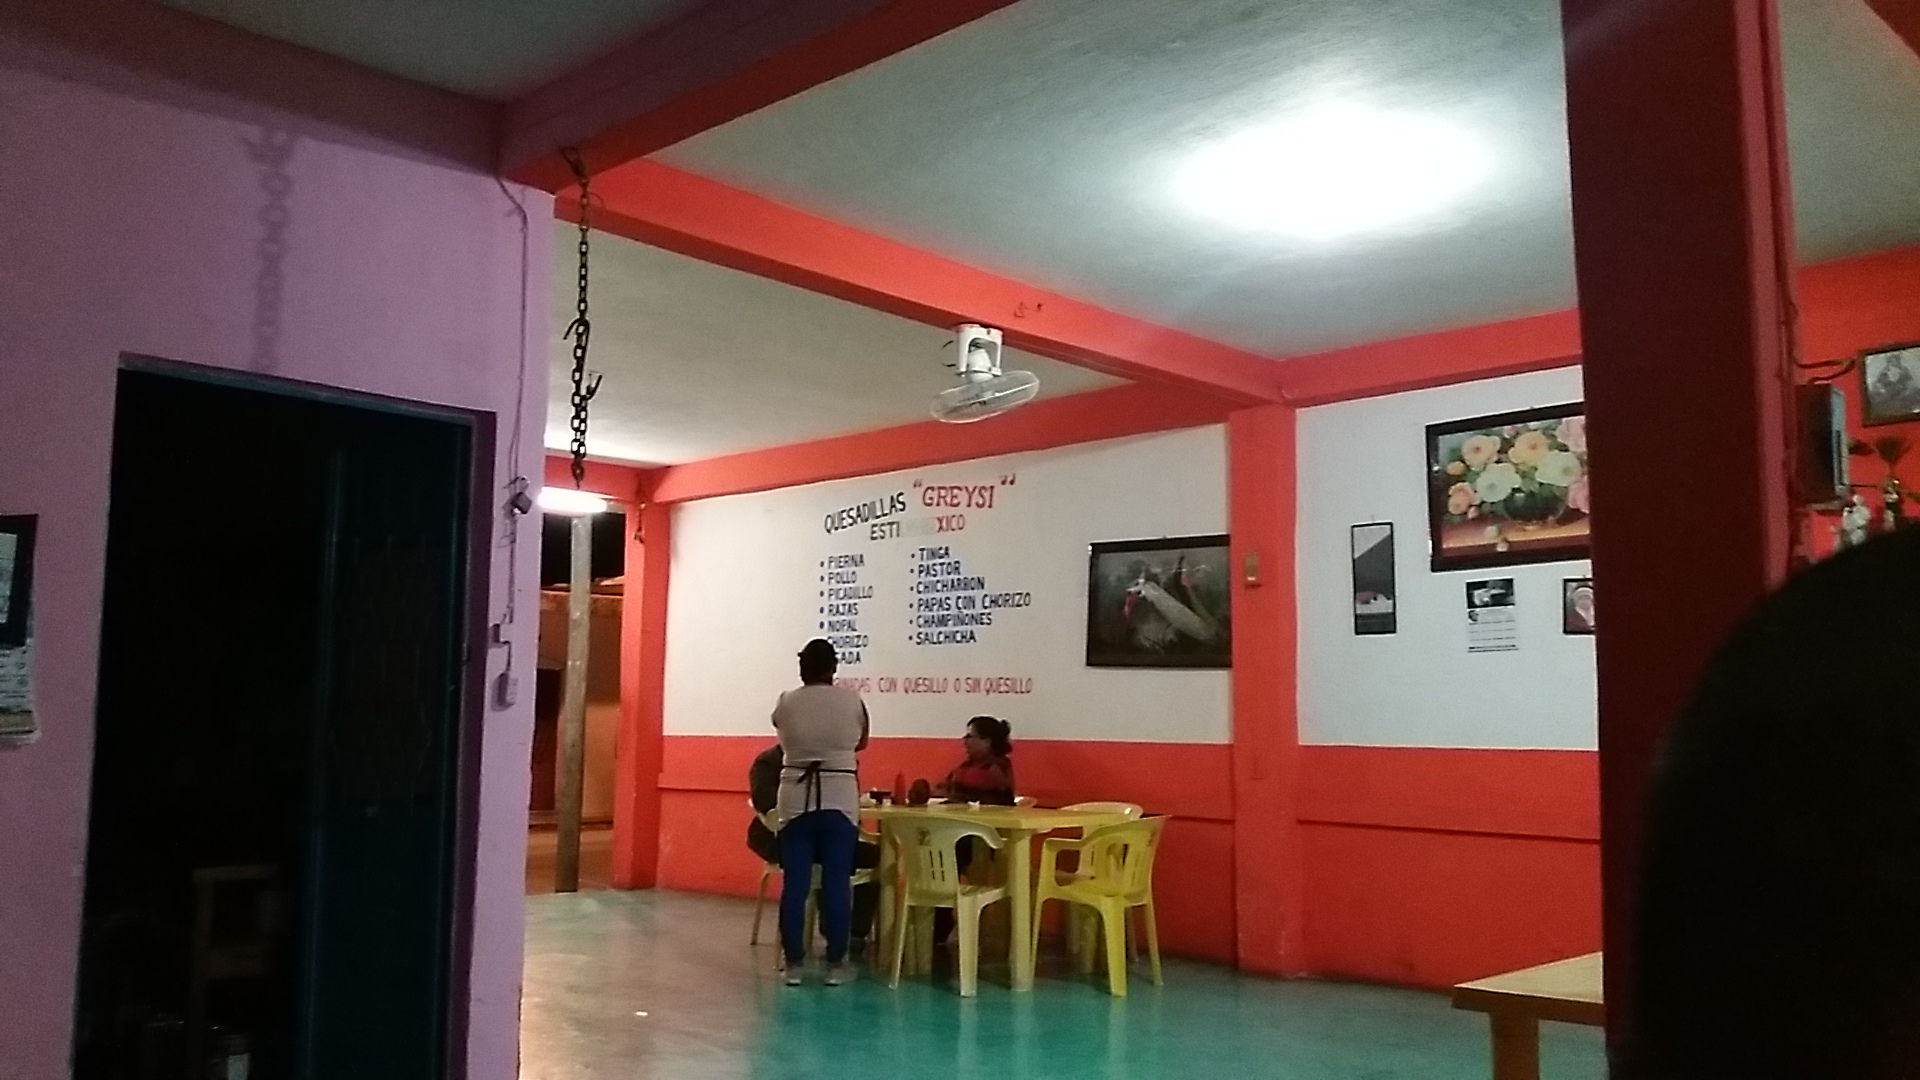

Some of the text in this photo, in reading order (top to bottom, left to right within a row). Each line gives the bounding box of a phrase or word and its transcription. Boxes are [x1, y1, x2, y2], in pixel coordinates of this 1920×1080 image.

[824, 491, 906, 534] QUESADILLAS
[828, 553, 865, 570] PIERNA
[918, 560, 961, 578] PASTOR
[828, 571, 857, 585] POLLO
[916, 576, 985, 594] CHICHARRON
[828, 586, 874, 601] PICADILLO
[917, 591, 1031, 612] PAPAS CON CHORIZO
[828, 602, 858, 616] RAJAS
[828, 619, 857, 632] NOPAL
[916, 610, 993, 628] CHAMPIÑONES
[916, 629, 977, 645] SALCHICHA
[878, 677, 897, 693] CON
[903, 676, 948, 694] QUESILLO
[953, 677, 961, 693] O
[965, 676, 981, 693] SIN
[984, 676, 1032, 695] QUESILLO
